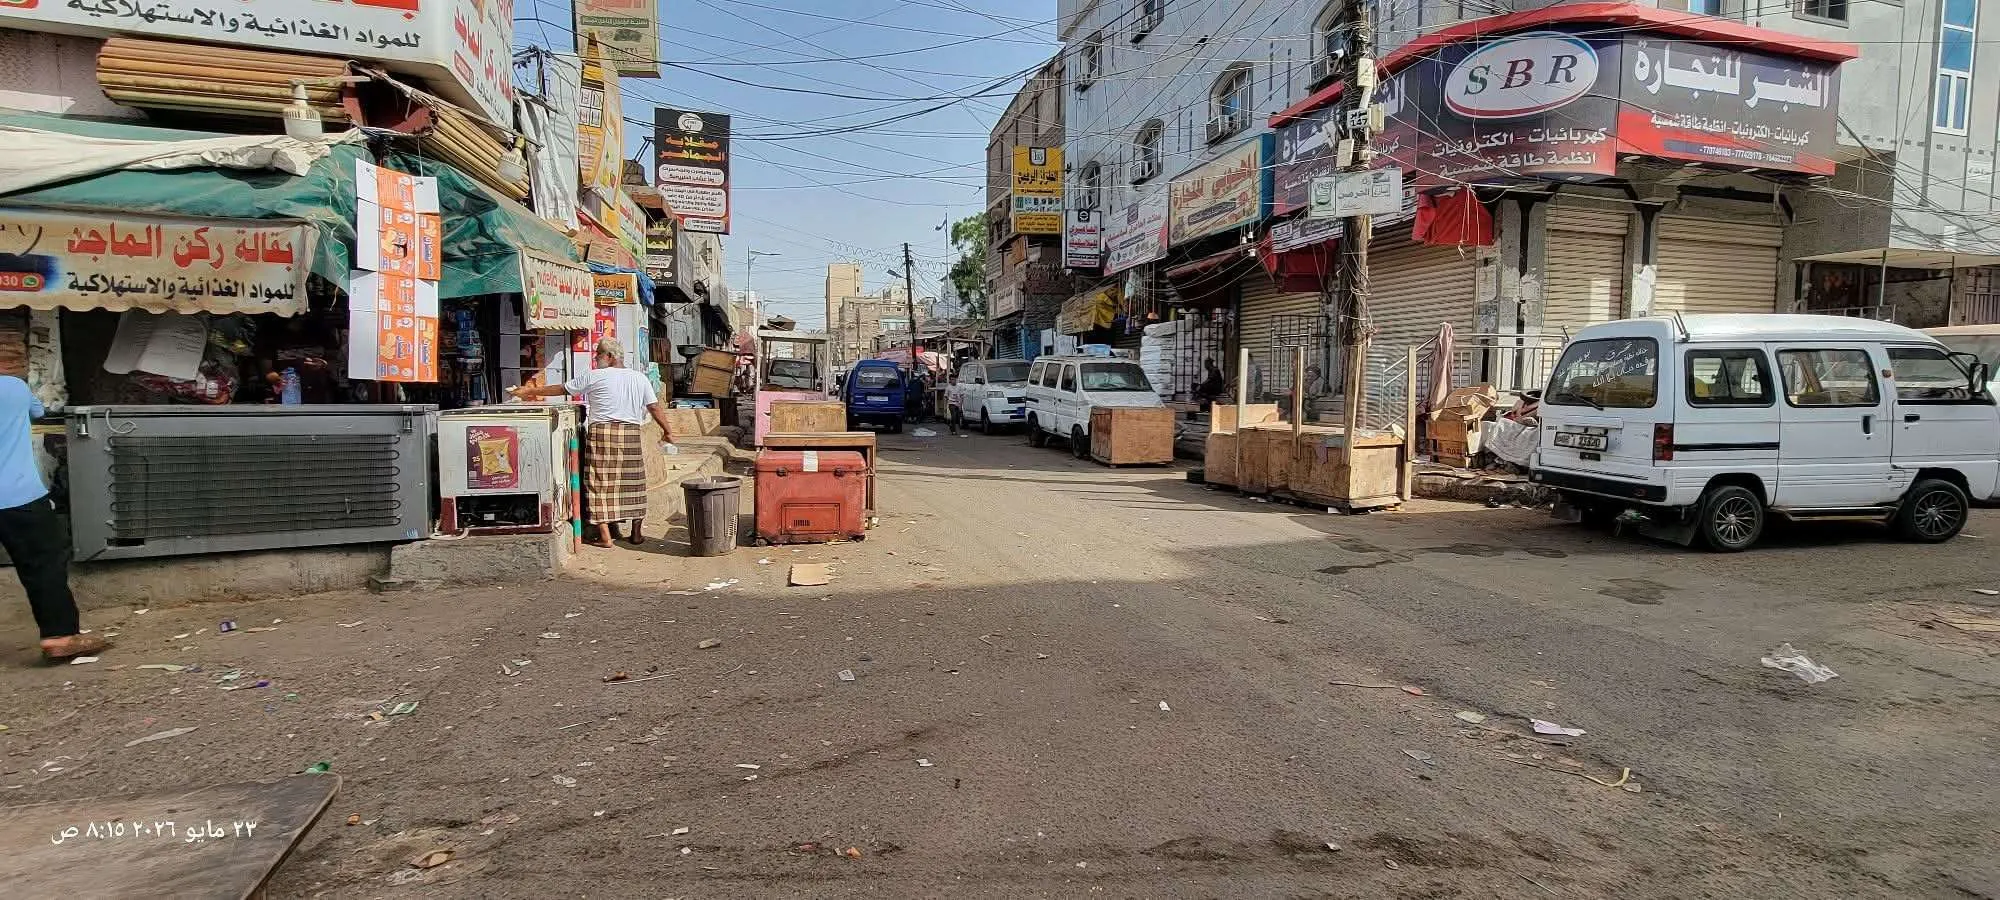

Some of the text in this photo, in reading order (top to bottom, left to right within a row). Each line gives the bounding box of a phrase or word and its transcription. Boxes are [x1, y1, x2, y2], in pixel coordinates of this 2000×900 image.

[242, 12, 349, 41] الغذائية
[355, 29, 421, 48] للمواد
[1464, 55, 1578, 95] SBR
[1634, 39, 1740, 99] للتجارة
[1432, 131, 1514, 157] الكترونيات
[1528, 127, 1607, 145] كهربائيات
[1439, 151, 1596, 179] انظمة طاقة شمسية
[67, 222, 295, 271] بقالة ركن الماجد
[67, 271, 296, 301] للمواد الغذائية والاستهلاكية
